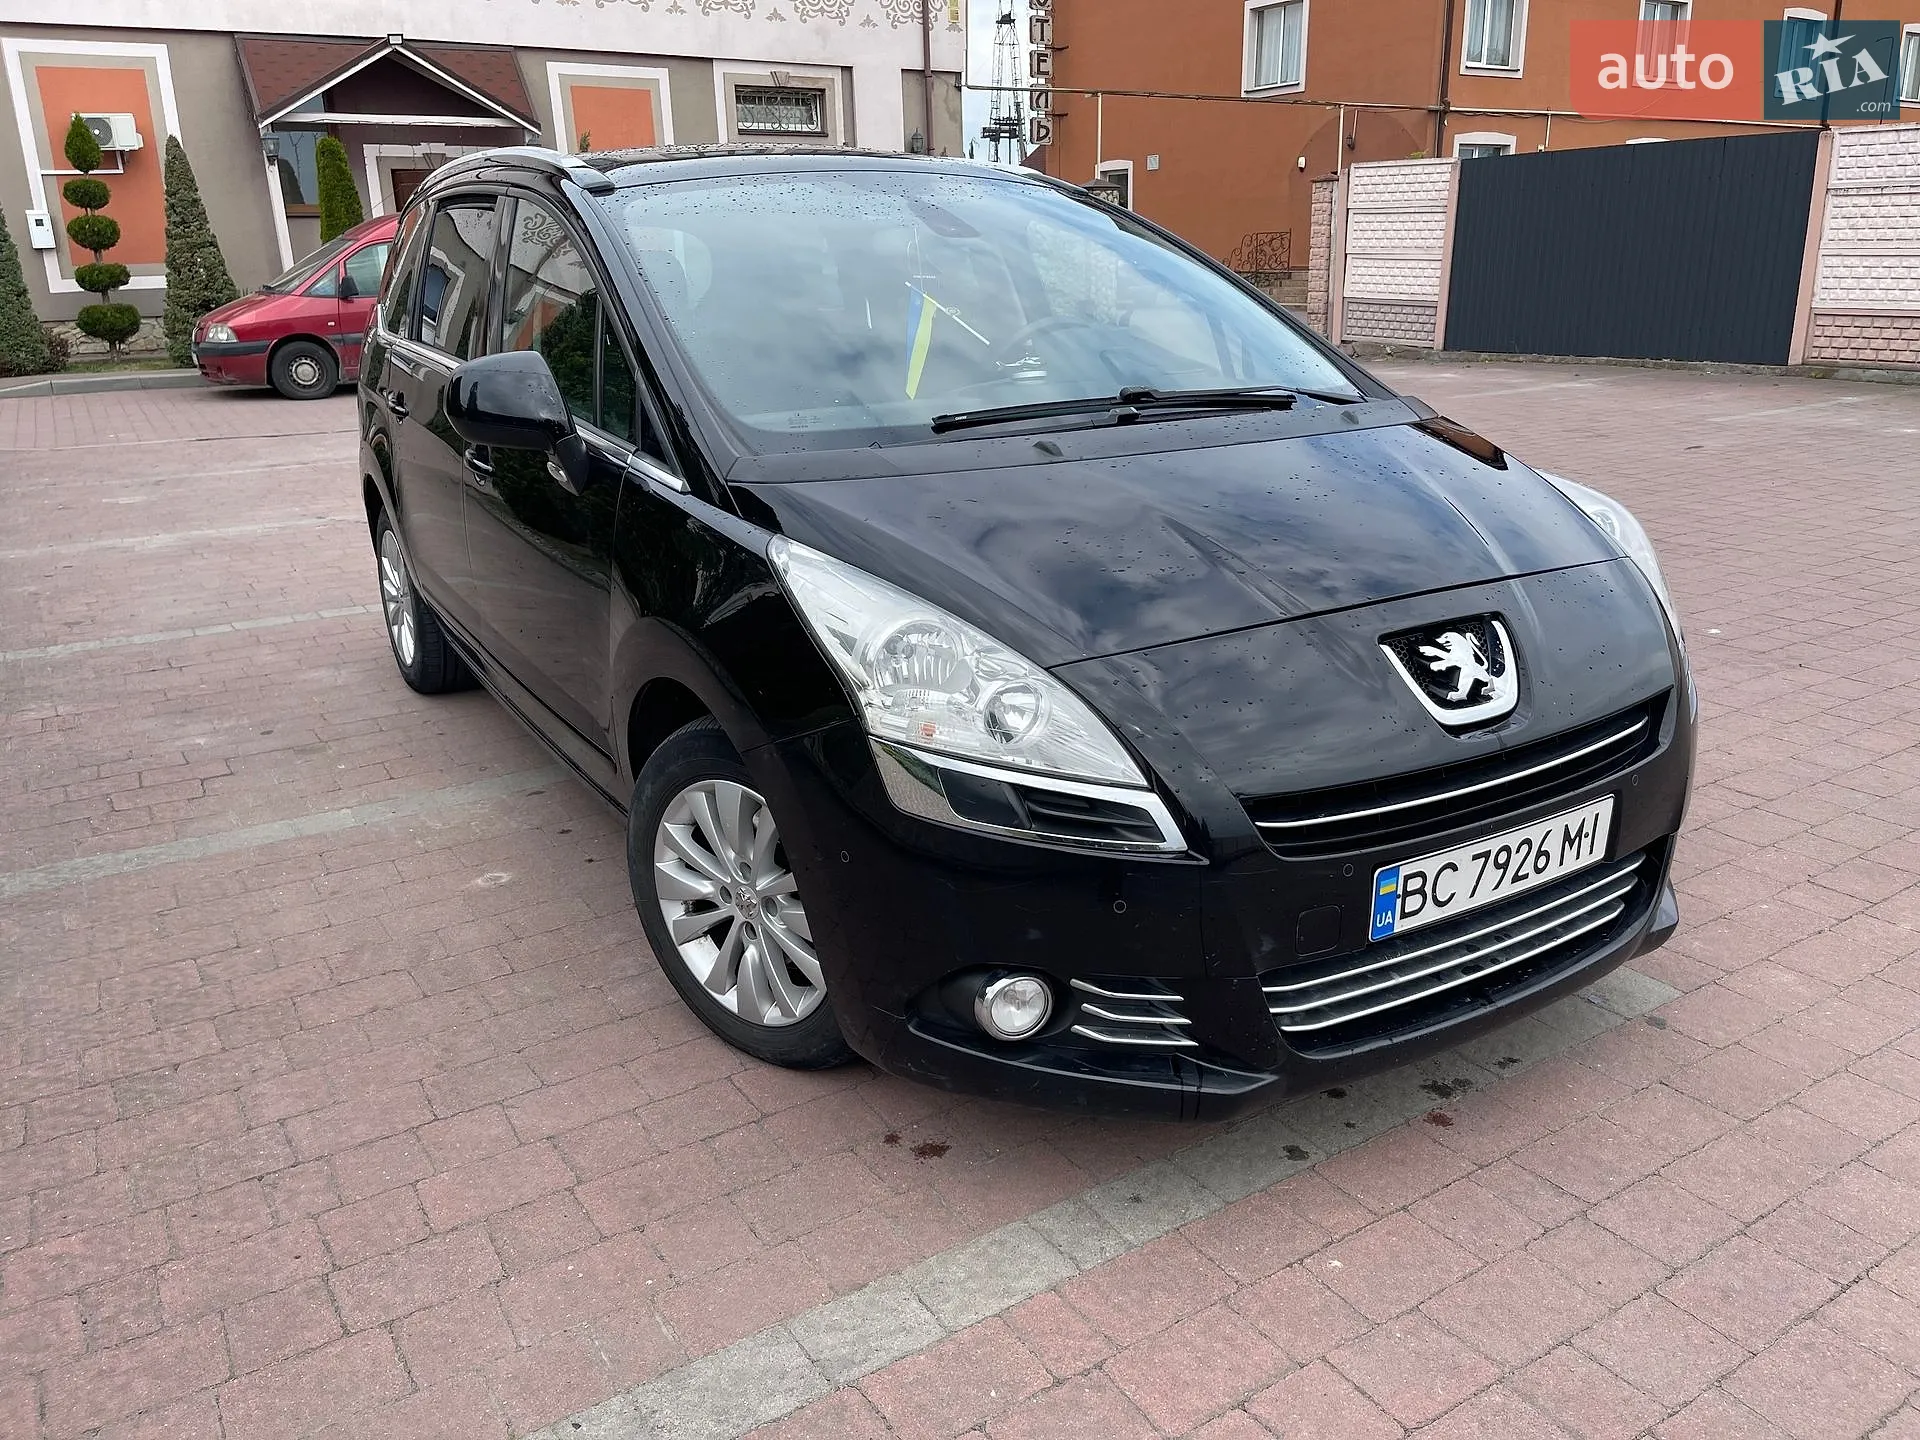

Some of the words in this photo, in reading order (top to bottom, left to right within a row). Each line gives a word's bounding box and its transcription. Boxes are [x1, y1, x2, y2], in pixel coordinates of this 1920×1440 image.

[1399, 861, 1459, 920] BC
[1469, 829, 1553, 899] 7926
[1376, 911, 1393, 928] UA
